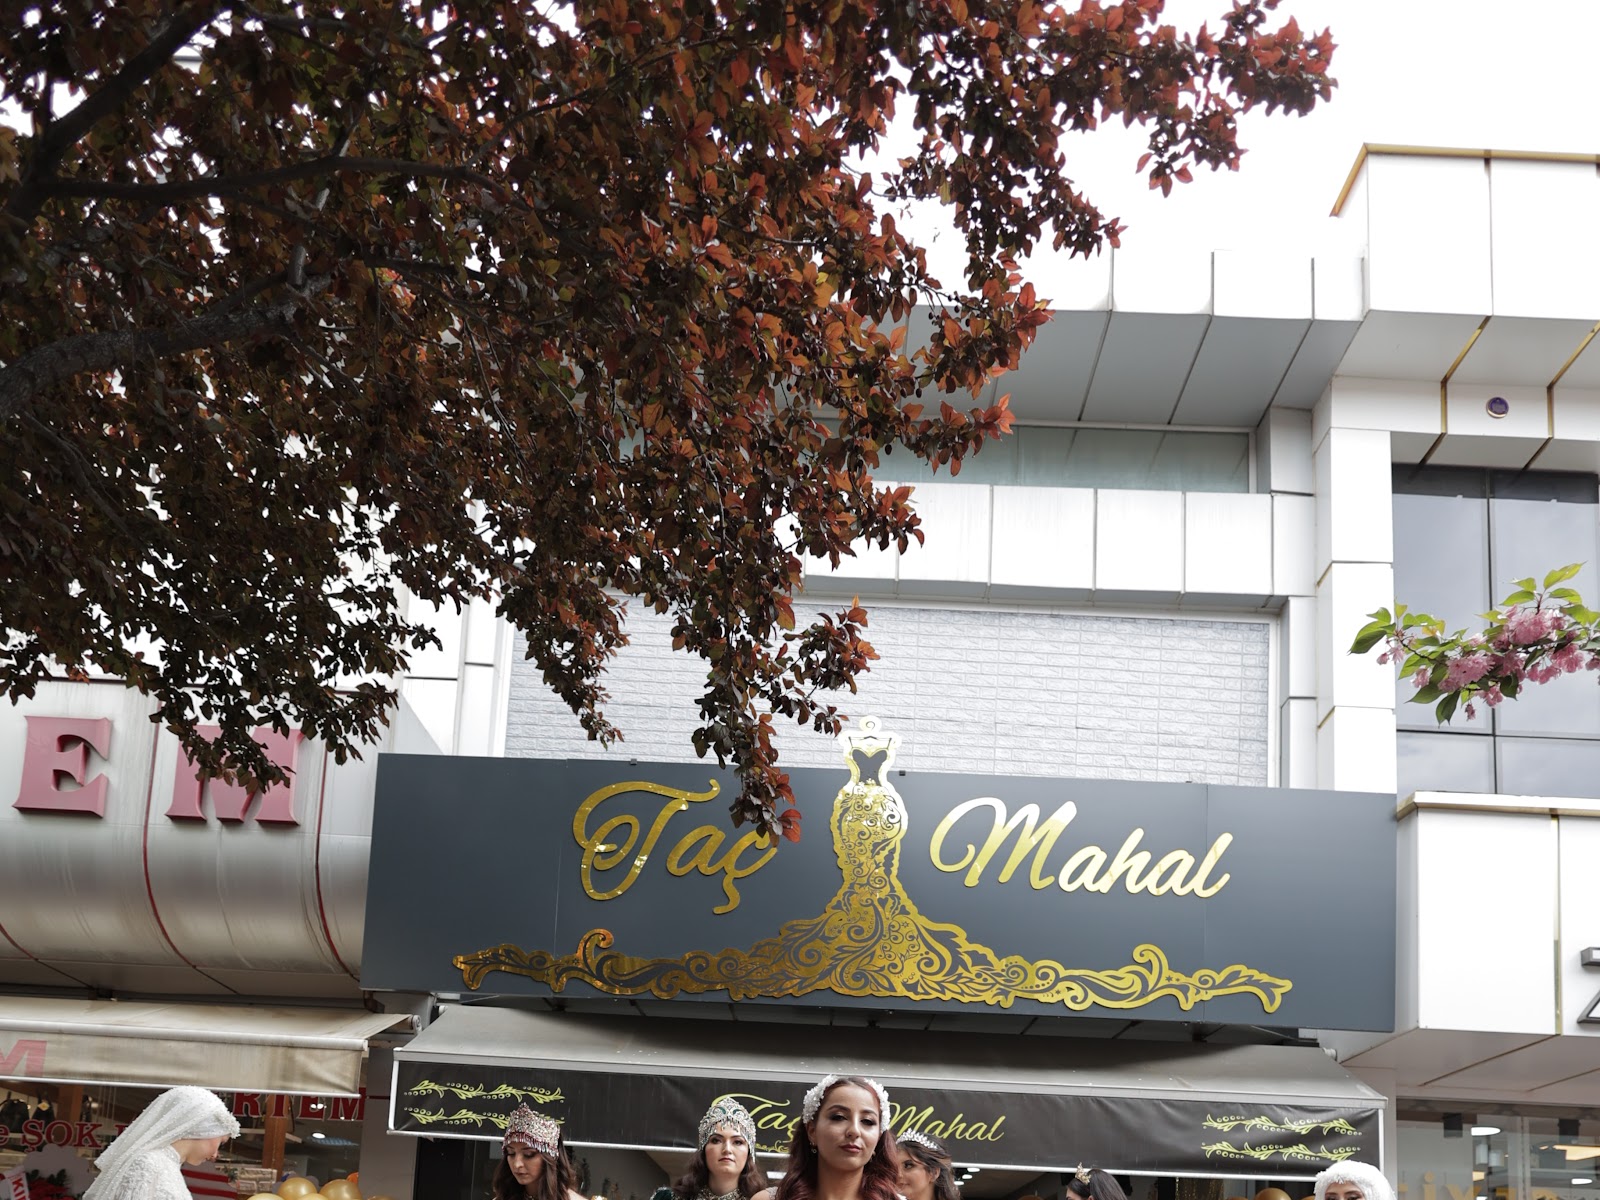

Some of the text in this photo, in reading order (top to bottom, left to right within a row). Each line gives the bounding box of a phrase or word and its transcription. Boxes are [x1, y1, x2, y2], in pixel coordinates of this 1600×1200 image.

[572, 778, 1234, 914] Taç Mahal
[22, 1120, 103, 1152] ŞOK
[888, 1102, 1006, 1142] Mahal
